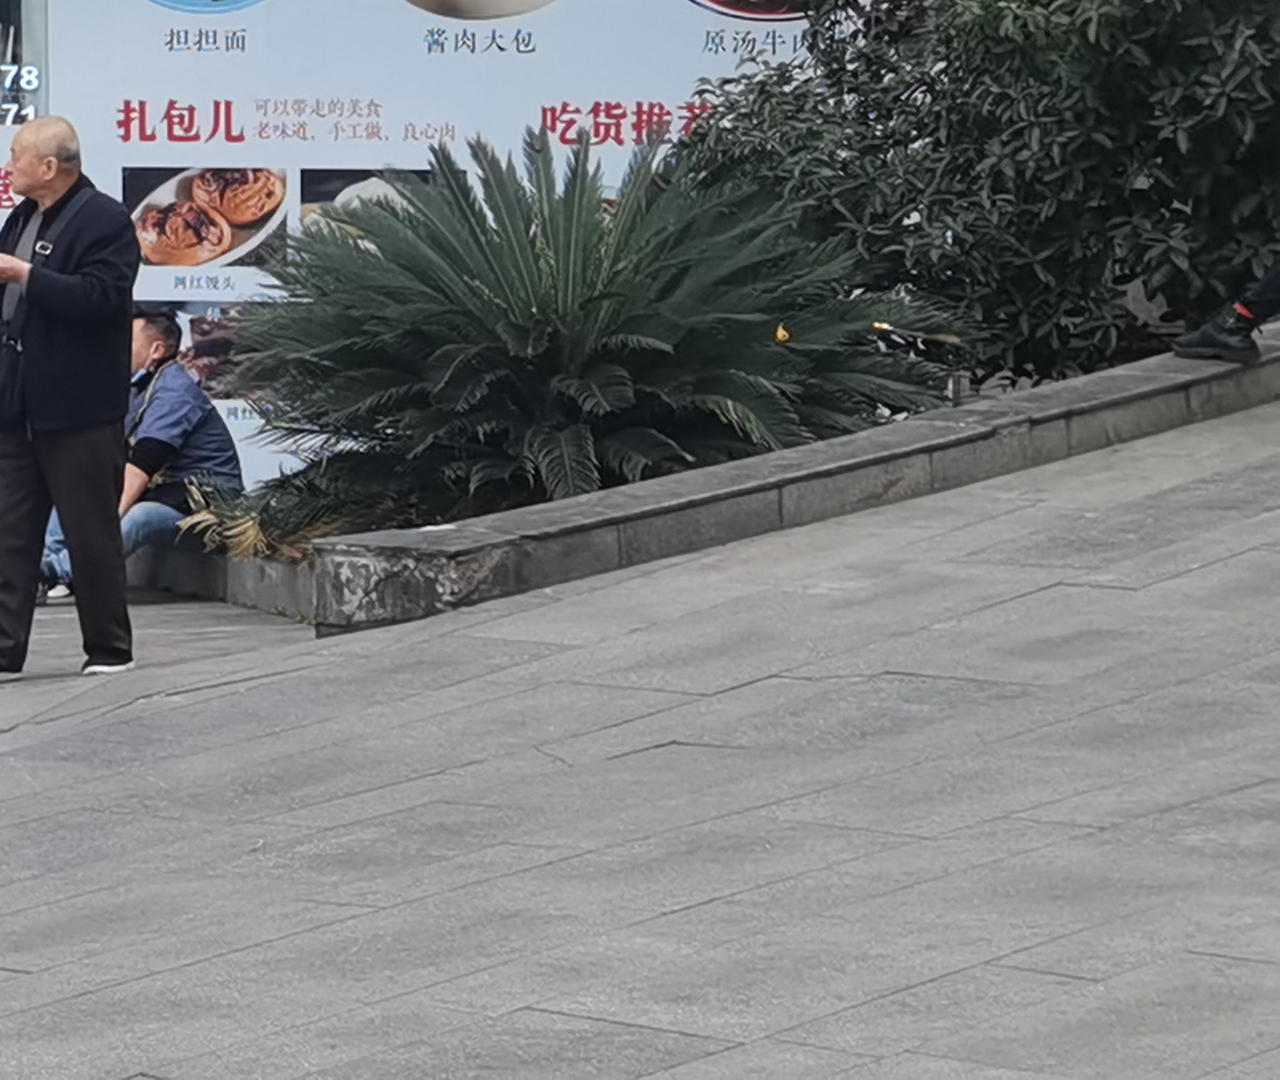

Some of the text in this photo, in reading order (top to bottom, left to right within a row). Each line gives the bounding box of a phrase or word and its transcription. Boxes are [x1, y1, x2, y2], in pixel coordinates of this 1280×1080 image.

[165, 28, 248, 53] 担担面
[423, 28, 537, 55] 酱肉大包
[254, 98, 384, 118] 可以带走的美食
[116, 99, 246, 144] 扎包儿
